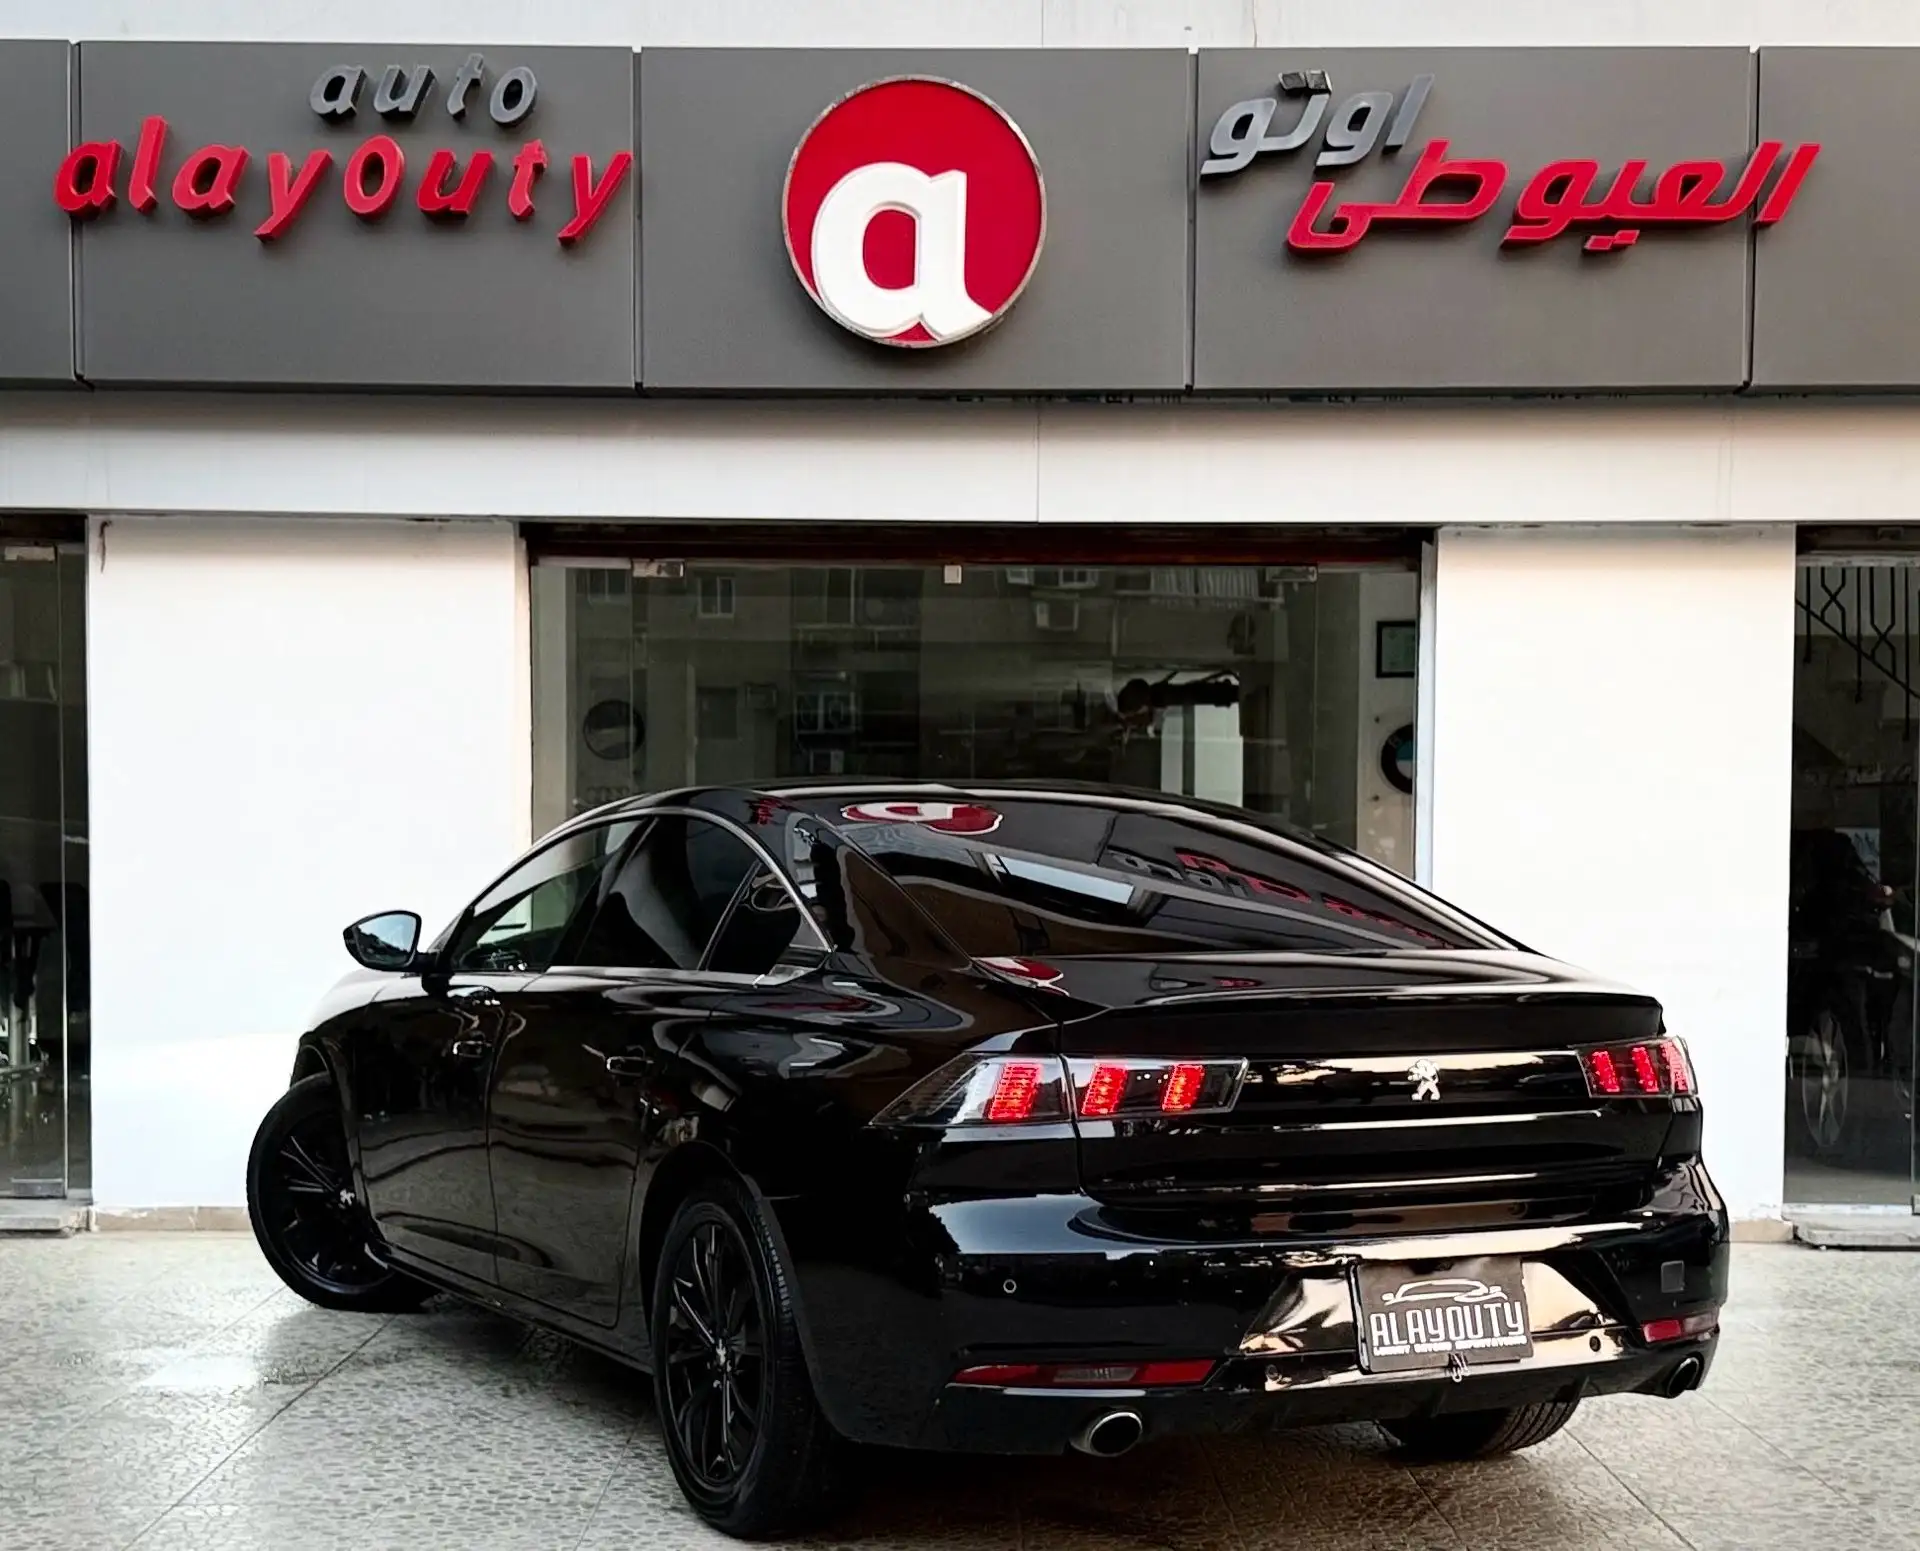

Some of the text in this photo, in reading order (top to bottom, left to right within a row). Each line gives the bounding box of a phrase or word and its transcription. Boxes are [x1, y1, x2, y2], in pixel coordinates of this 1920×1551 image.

[310, 54, 538, 125] auto
[1200, 70, 1435, 174] اوتو
[811, 161, 993, 341] a
[1370, 1302, 1525, 1347] ALAYOUTY
